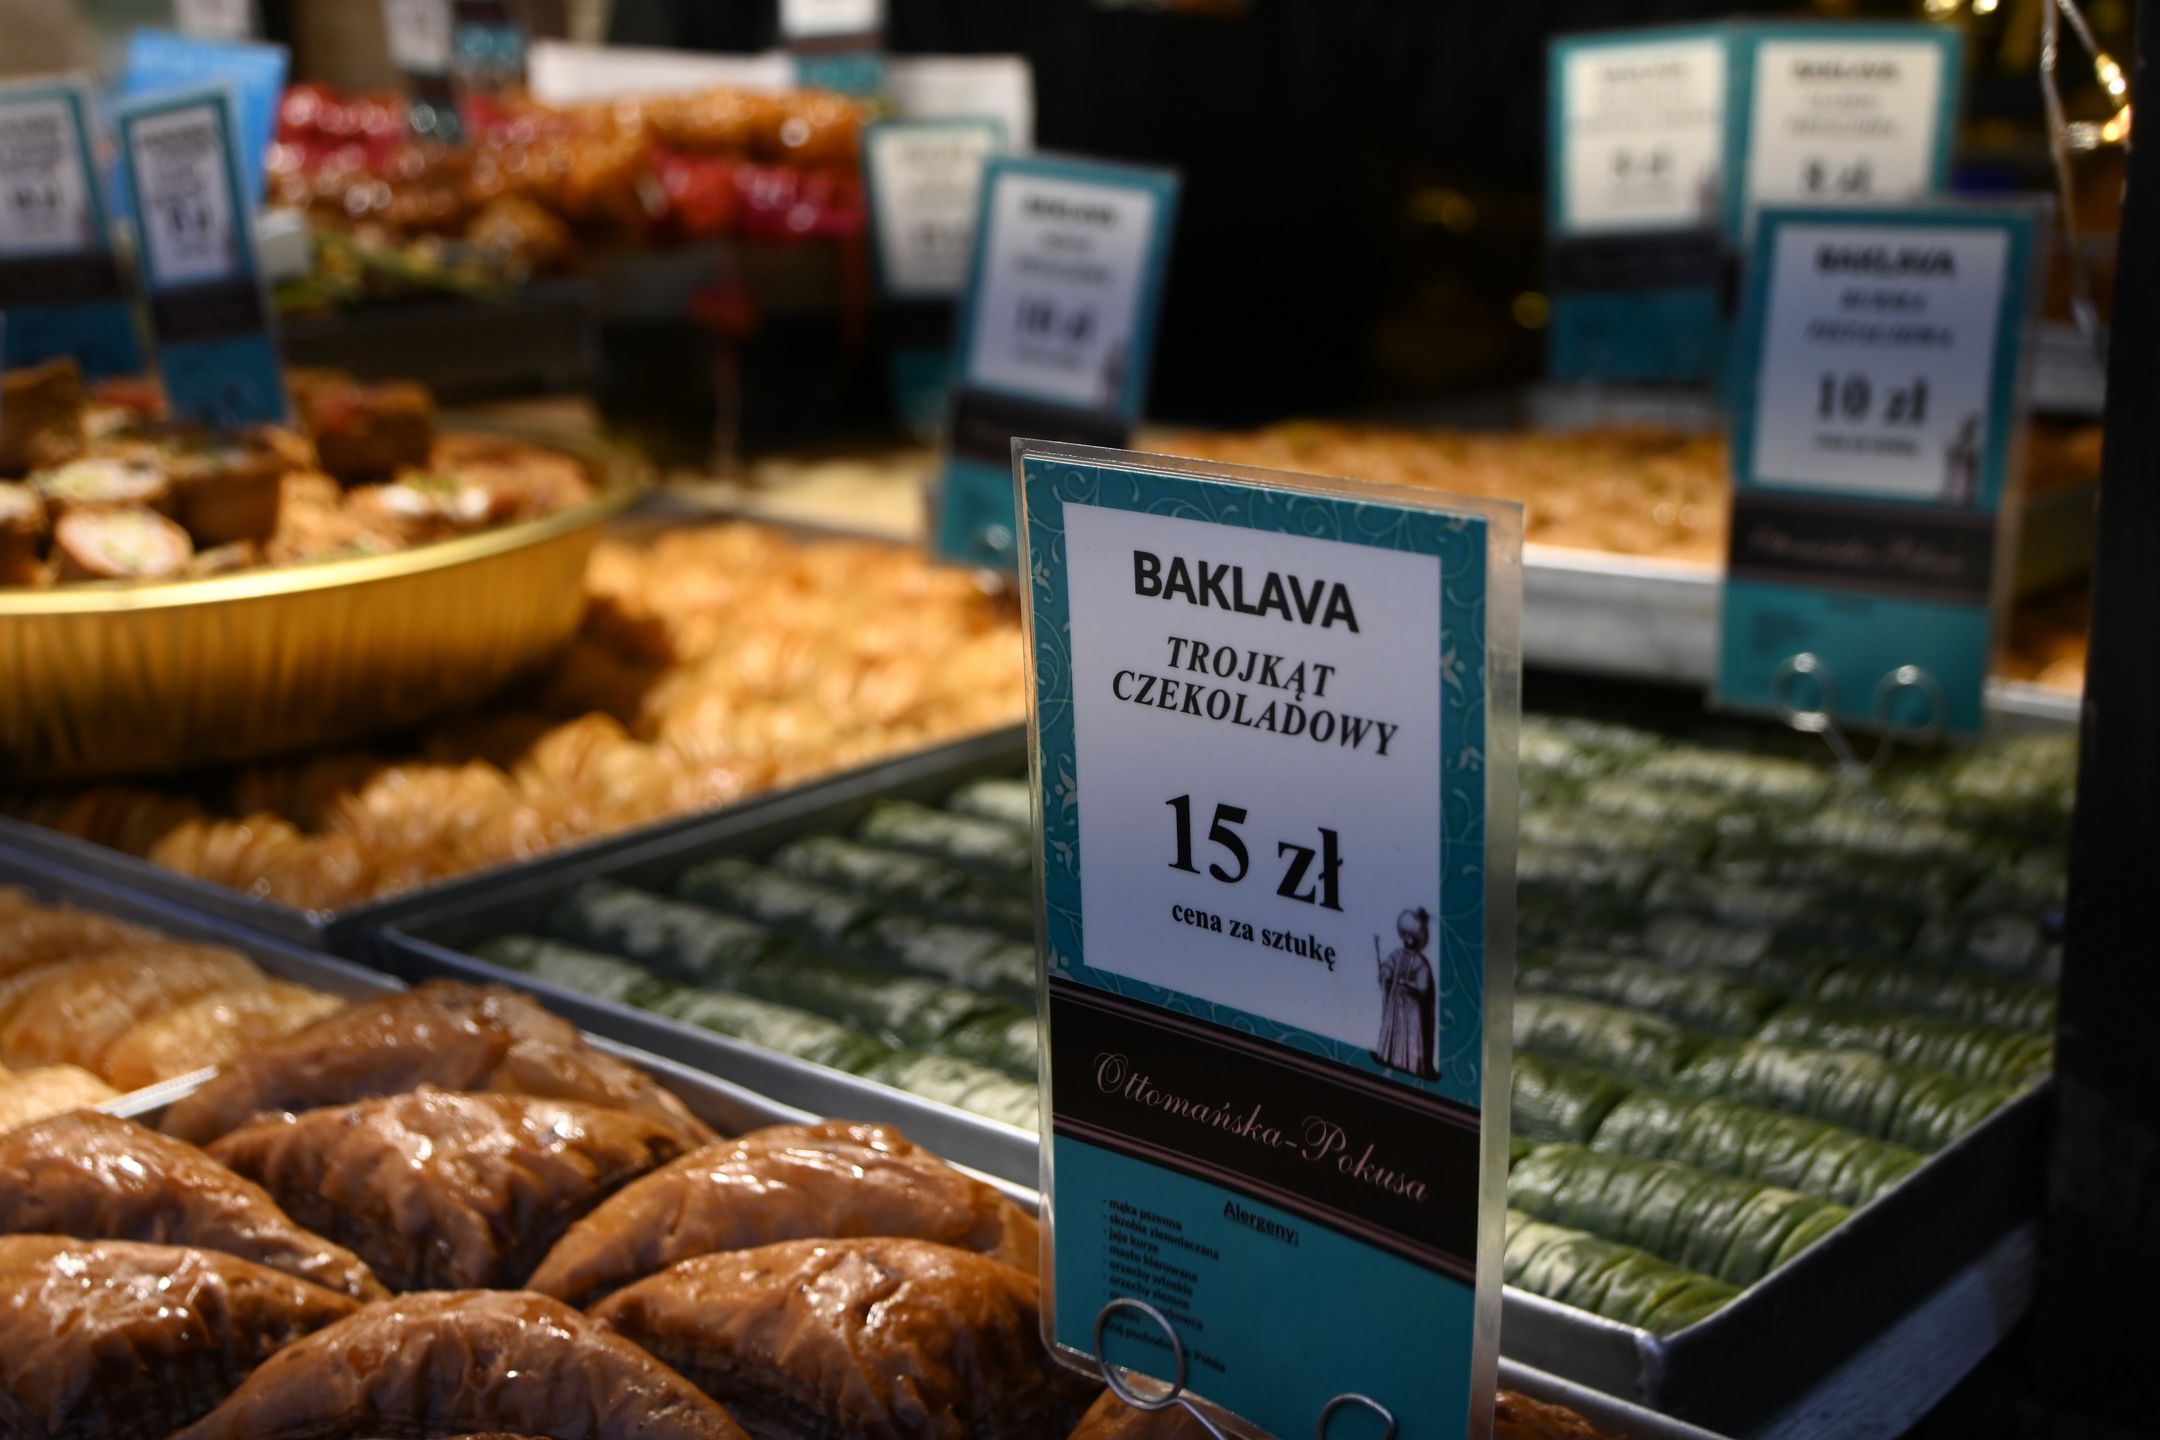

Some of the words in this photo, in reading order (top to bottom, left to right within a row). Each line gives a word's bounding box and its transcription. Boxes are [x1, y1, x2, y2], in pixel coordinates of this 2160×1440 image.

[1818, 371, 1872, 423] 10
[1133, 550, 1360, 634] BAKLAVA
[1167, 636, 1335, 700] TROJKĄT
[1112, 670, 1398, 757] CZEKOLADOWY
[1165, 795, 1250, 884] 15
[1276, 827, 1344, 912] zł
[1172, 903, 1222, 933] cena
[1229, 918, 1254, 942] za
[1261, 926, 1336, 970] sztukę
[1093, 1051, 1429, 1201] Ottomańska-Pokusa
[1109, 1214, 1147, 1234] skrobia
[1149, 1226, 1220, 1261] ziemniaczana
[1139, 1209, 1182, 1231] pszenna
[1223, 1199, 1300, 1247] Alergeny:
